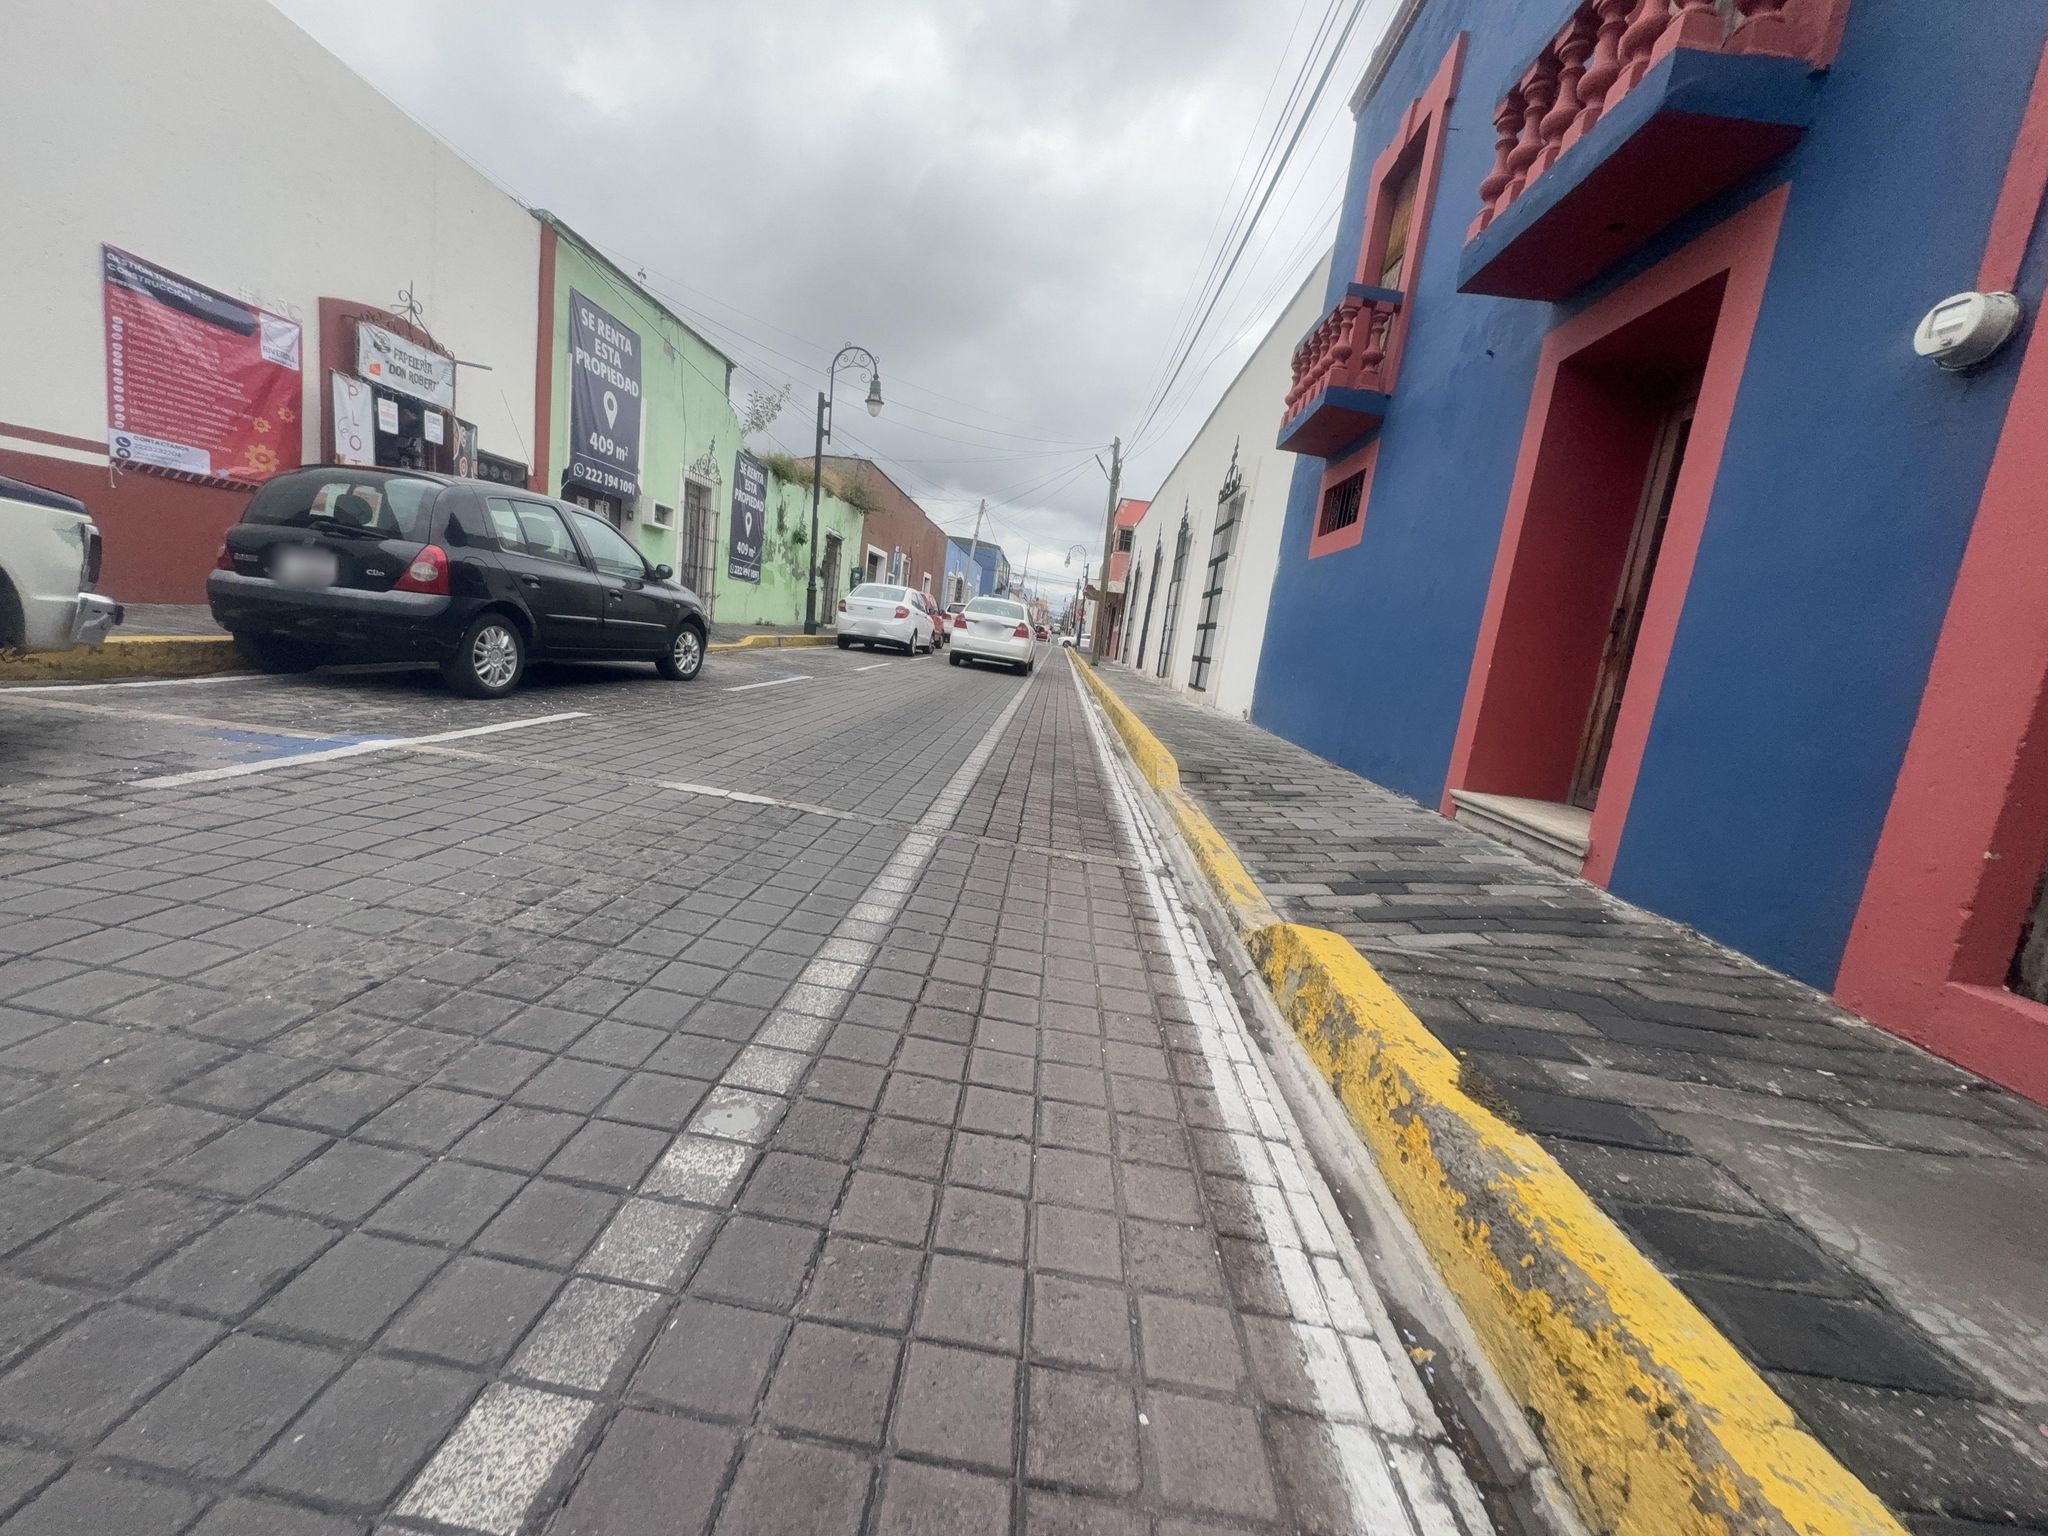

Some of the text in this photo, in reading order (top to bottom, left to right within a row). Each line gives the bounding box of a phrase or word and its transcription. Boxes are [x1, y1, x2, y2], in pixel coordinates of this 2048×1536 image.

[581, 308, 632, 356] SE RENTA
[594, 338, 621, 369] ESTA
[575, 346, 639, 397] PROPIEDAD
[589, 432, 614, 456] 409
[585, 466, 635, 496] 222 194 1091
[740, 462, 764, 484] SE RENTA
[744, 479, 758, 495] ESTA
[734, 488, 765, 513] PROPIEDAD
[736, 541, 749, 556] 409
[366, 568, 385, 577] Clio
